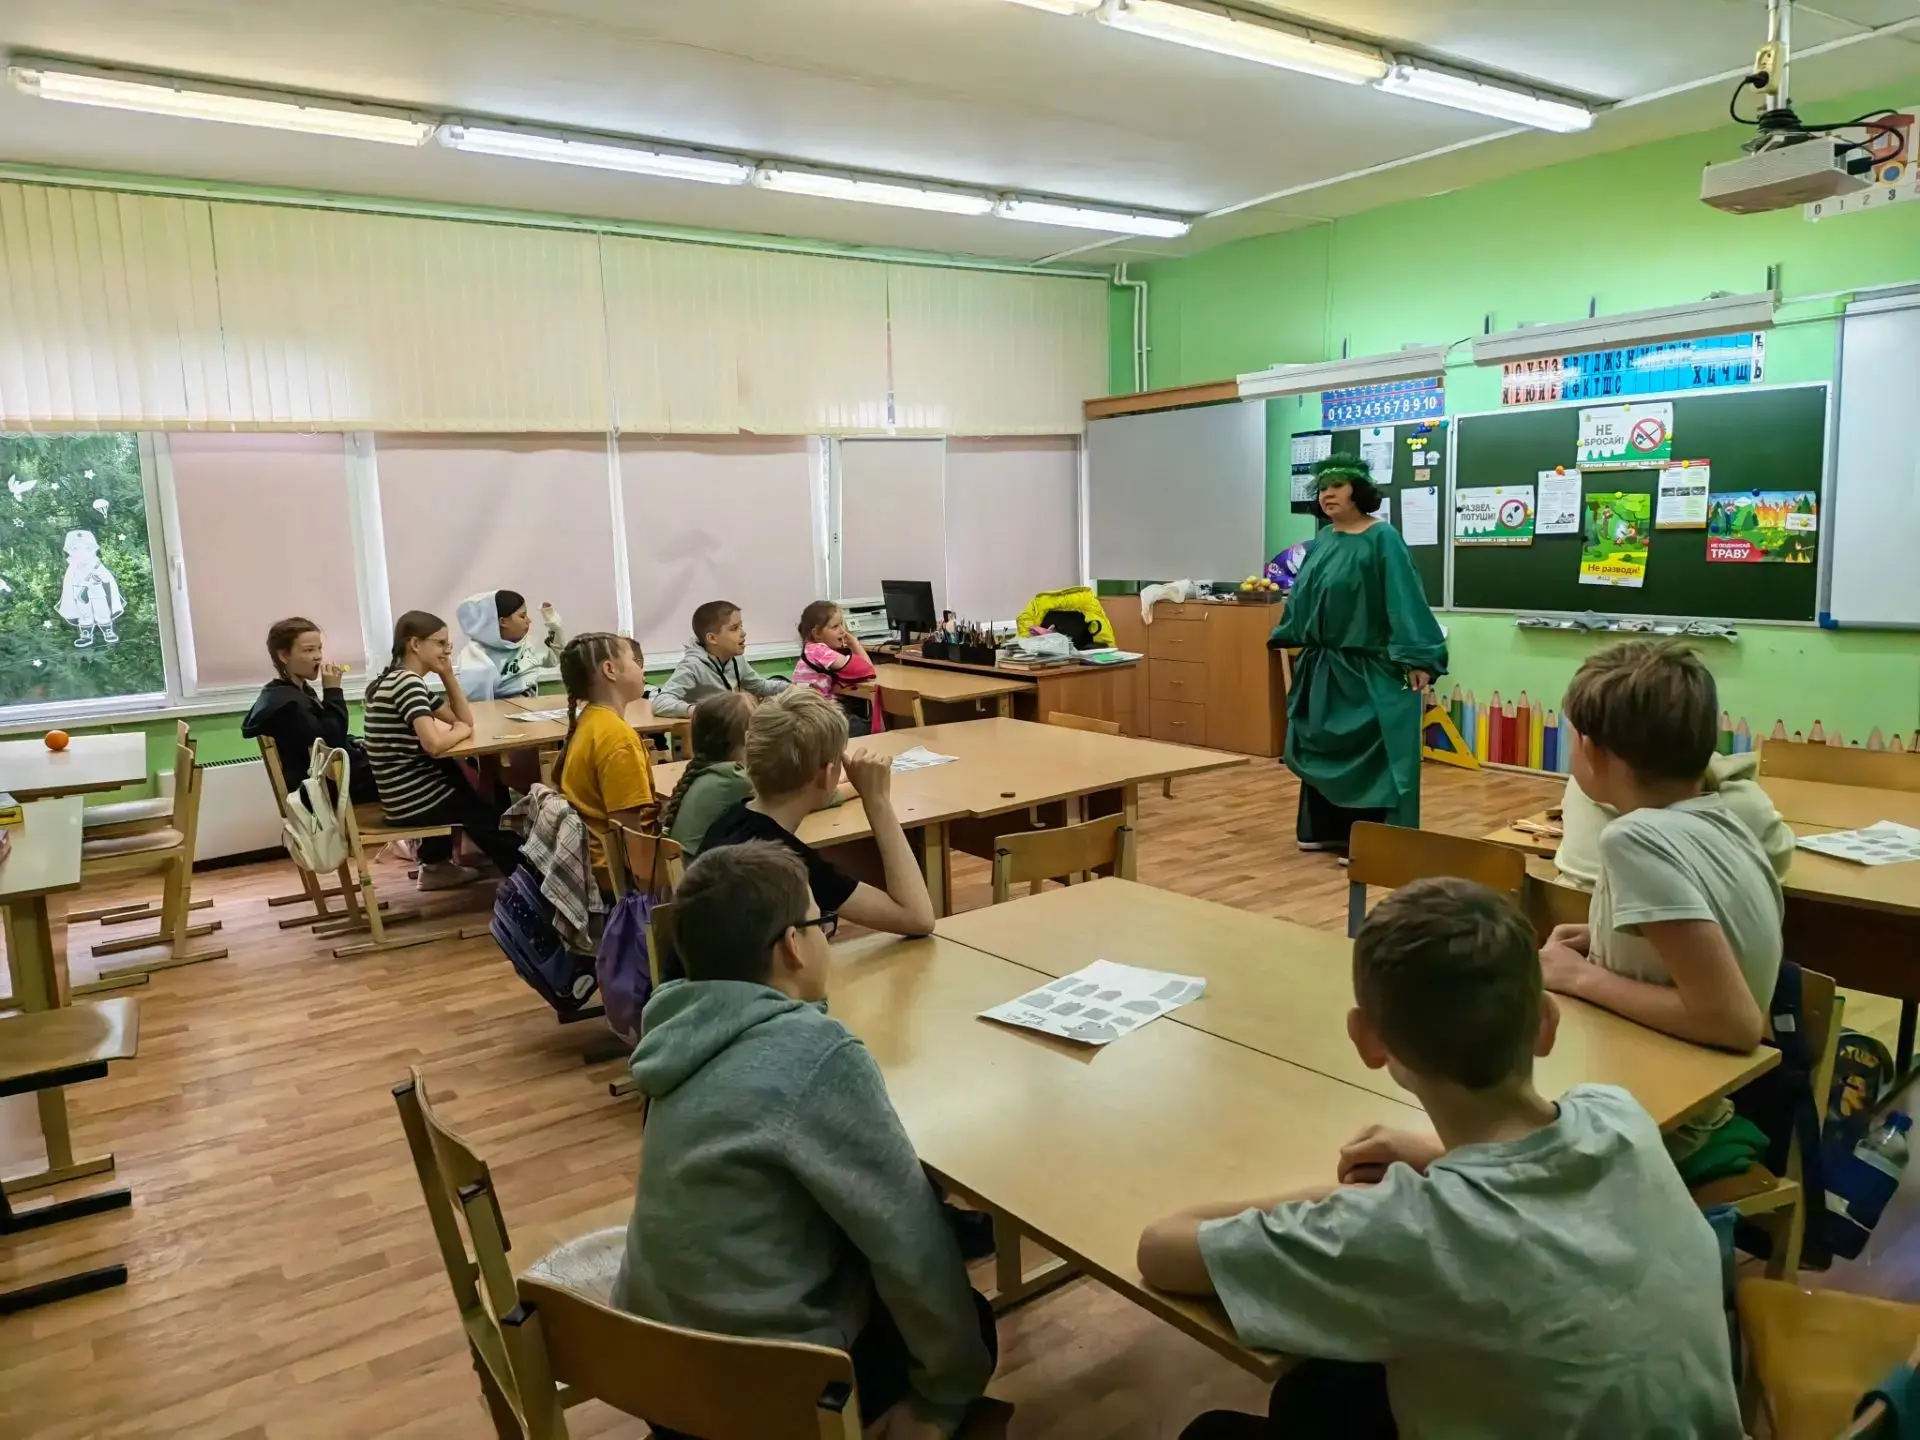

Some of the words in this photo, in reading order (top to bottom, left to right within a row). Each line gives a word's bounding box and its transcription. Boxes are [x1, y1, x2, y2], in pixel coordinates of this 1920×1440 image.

[1814, 203, 1821, 215] 0
[1840, 199, 1844, 210] 1
[1863, 194, 1871, 206] 2
[1888, 188, 1896, 200] 3
[1604, 352, 1612, 371] Ж
[1573, 379, 1579, 397] Ф
[1583, 378, 1589, 396] К
[1615, 375, 1621, 394] С
[1329, 409, 1335, 420] 0
[1346, 406, 1352, 418] 2
[1355, 405, 1361, 417] 3
[1364, 404, 1371, 416] 4
[1374, 403, 1381, 415] 5
[1384, 401, 1390, 414] 6
[1393, 400, 1400, 413] 7
[1403, 399, 1410, 412] 8
[1413, 398, 1420, 411] 9
[1424, 396, 1436, 409] 10
[1595, 424, 1613, 436] НЕ
[1584, 435, 1625, 447] БРОСАЙ!
[1461, 512, 1496, 521] ПОТУШИ!
[1710, 549, 1750, 559] ТРАВУ
[1588, 563, 1600, 572] Не
[1602, 565, 1641, 575] разводи!
